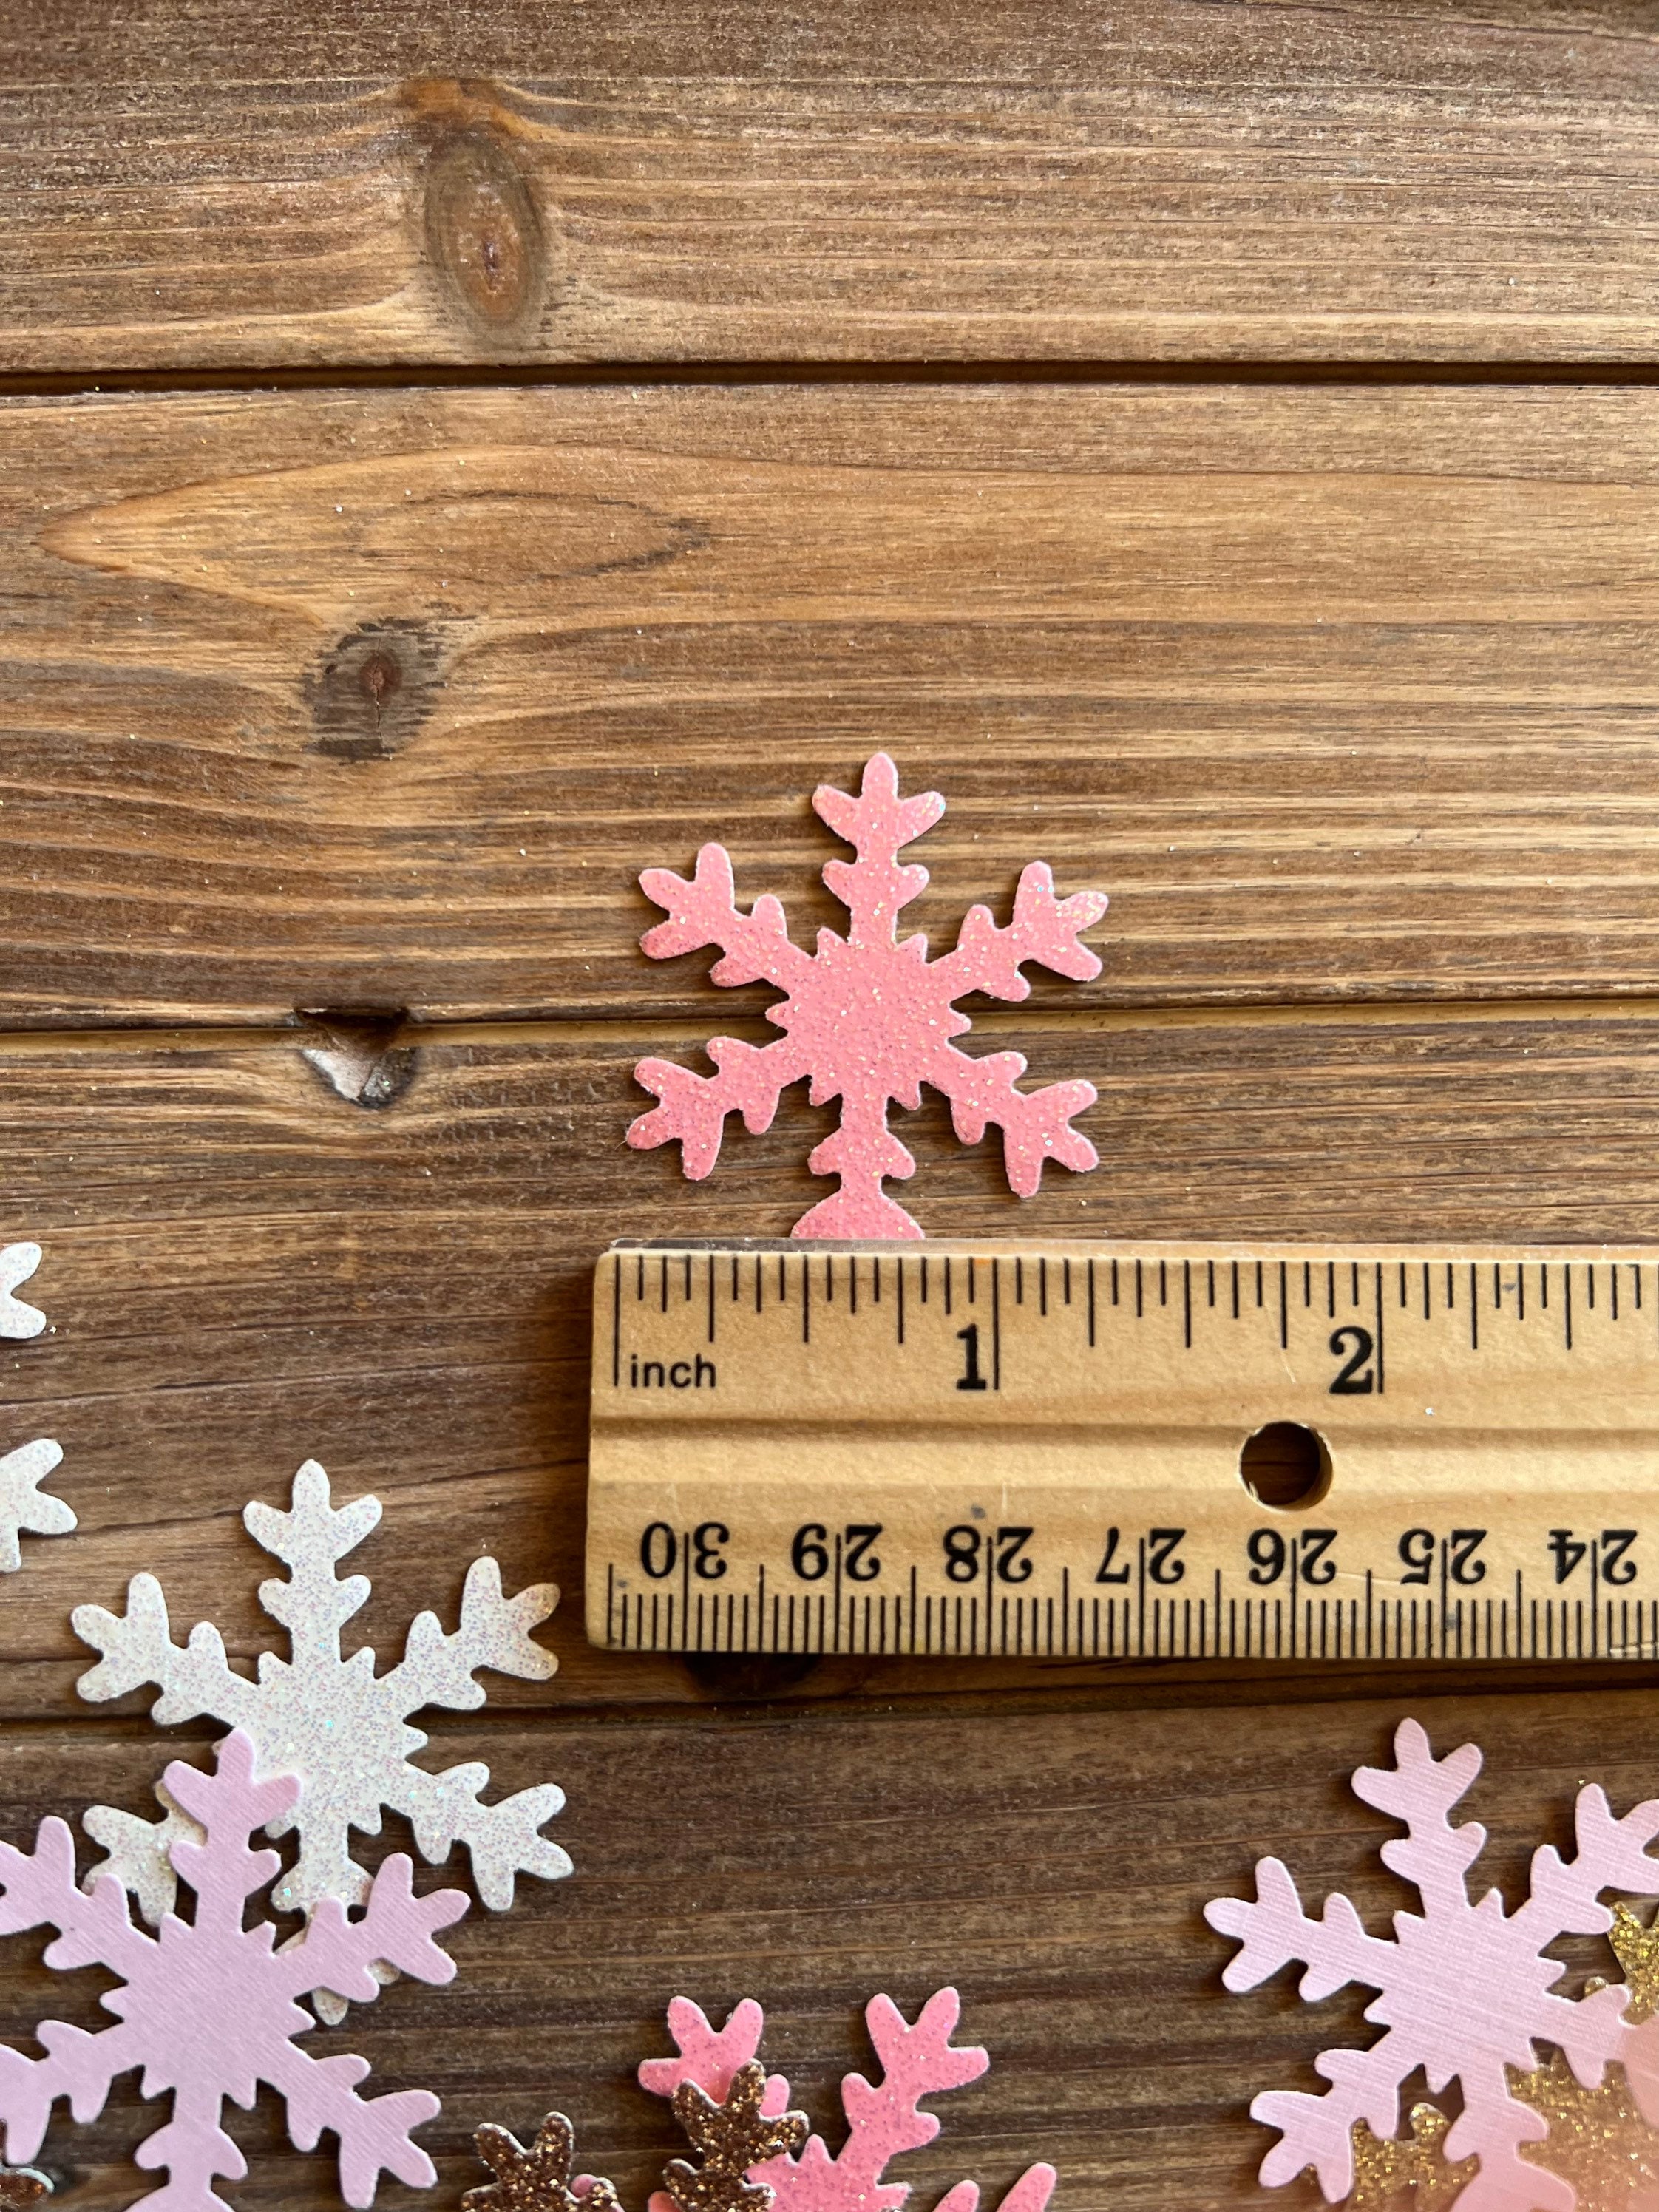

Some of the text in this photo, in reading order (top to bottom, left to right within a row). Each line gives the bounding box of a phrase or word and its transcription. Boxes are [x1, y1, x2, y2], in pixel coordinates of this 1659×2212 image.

[631, 1323, 1374, 1394] inch 1 2
[640, 1521, 1638, 1585] 24 25 26 27 28 29 30
